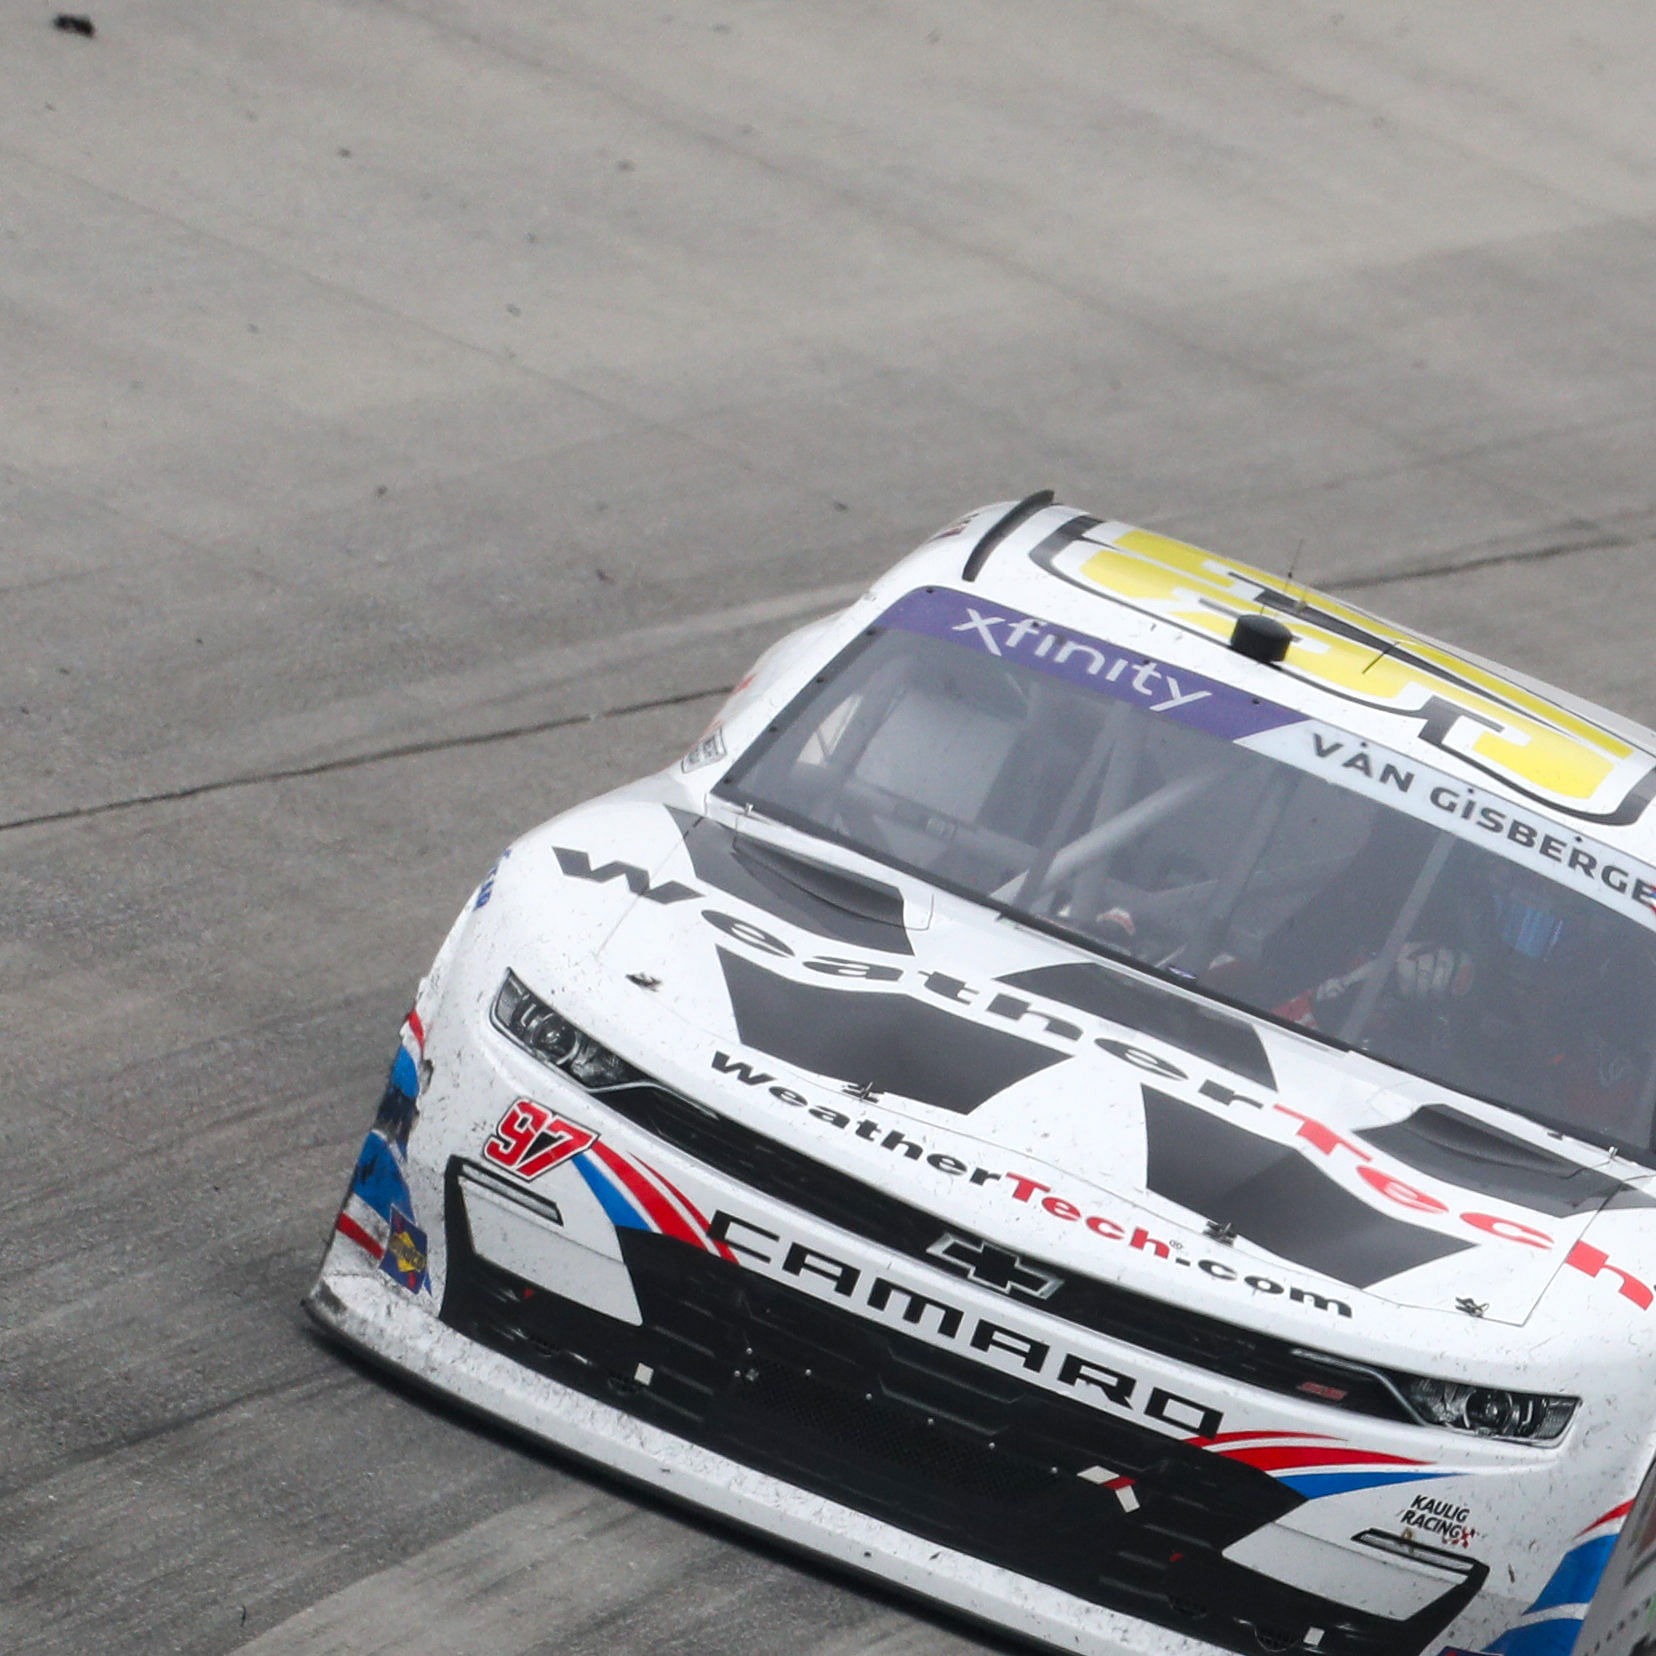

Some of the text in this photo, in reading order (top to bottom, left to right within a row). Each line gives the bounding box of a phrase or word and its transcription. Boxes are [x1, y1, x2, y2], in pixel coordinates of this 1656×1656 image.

[953, 608, 1212, 712] xfinity
[1312, 732, 1415, 794] VAN
[484, 1099, 598, 1181] 97
[706, 1208, 1224, 1440] CAMARO
[1400, 1511, 1464, 1539] RACING
[1411, 1495, 1470, 1523] KAULIG
